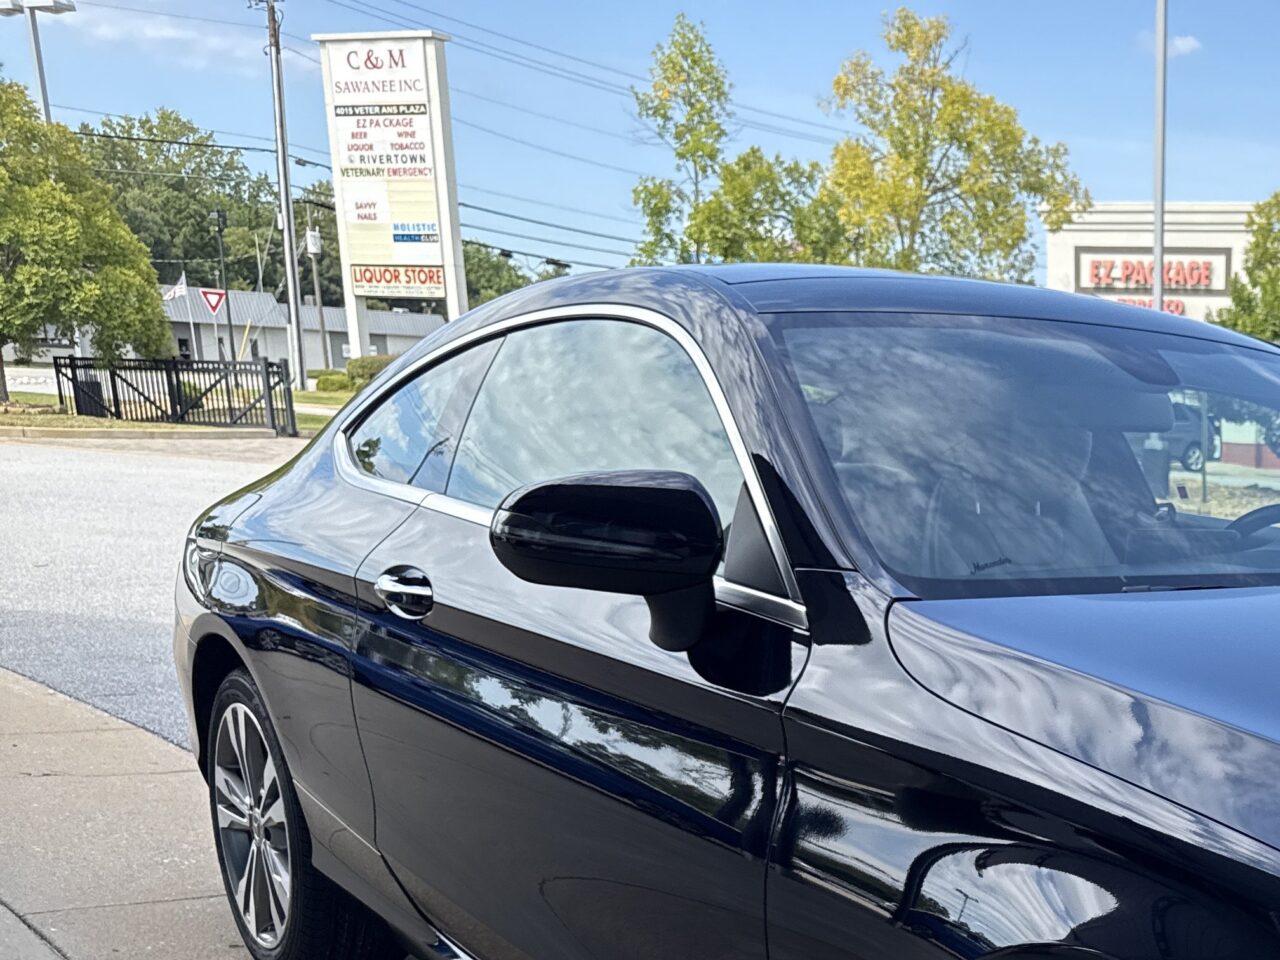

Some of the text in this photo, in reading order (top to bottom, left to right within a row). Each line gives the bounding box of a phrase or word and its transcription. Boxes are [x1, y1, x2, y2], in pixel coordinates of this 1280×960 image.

[346, 49, 407, 70] C & M
[335, 80, 397, 94] SAWANEE
[399, 104, 426, 113] PLAZA
[356, 119, 367, 128] EZ
[351, 130, 416, 139] BEER WINE
[347, 142, 425, 152] LIQUOR TOBACCO
[359, 153, 426, 164] RIVERTOWN
[341, 167, 432, 177] VETERINARY EMERGENCY
[355, 201, 377, 210] SAVVY
[357, 213, 377, 221] NAILS
[393, 222, 437, 232] HOLISTIC
[353, 268, 442, 284] LIQUOR STORE
[1090, 260, 1115, 285] EZ
